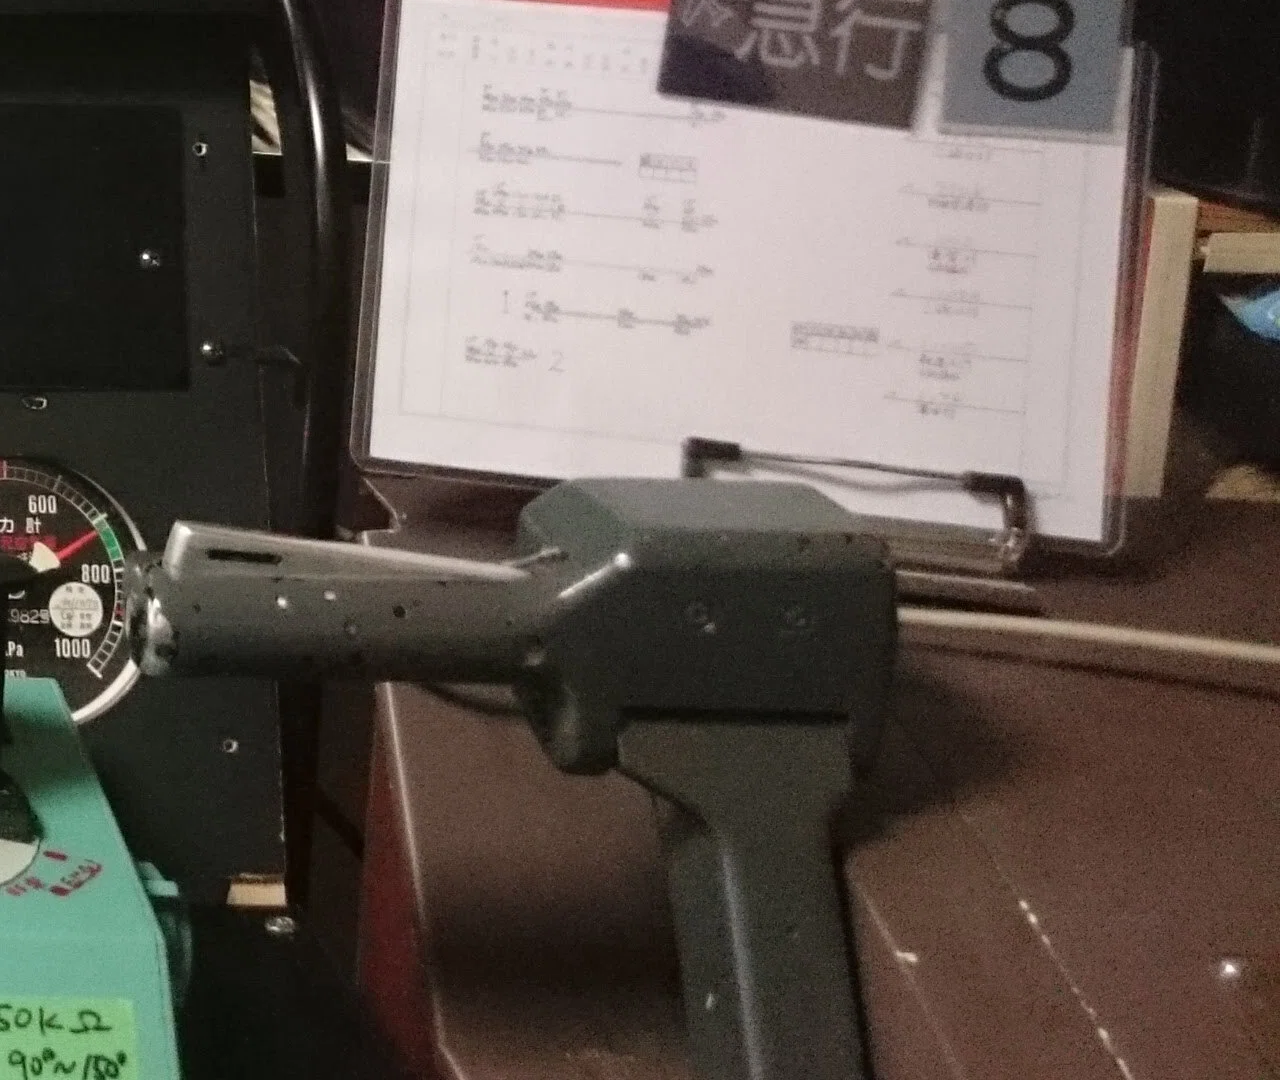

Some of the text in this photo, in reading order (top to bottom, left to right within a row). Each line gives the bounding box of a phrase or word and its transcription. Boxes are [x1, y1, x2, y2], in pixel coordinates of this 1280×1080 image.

[28, 495, 57, 514] 600
[81, 564, 110, 584] 800
[5, 641, 24, 658] Pa
[54, 638, 91, 658] 1000
